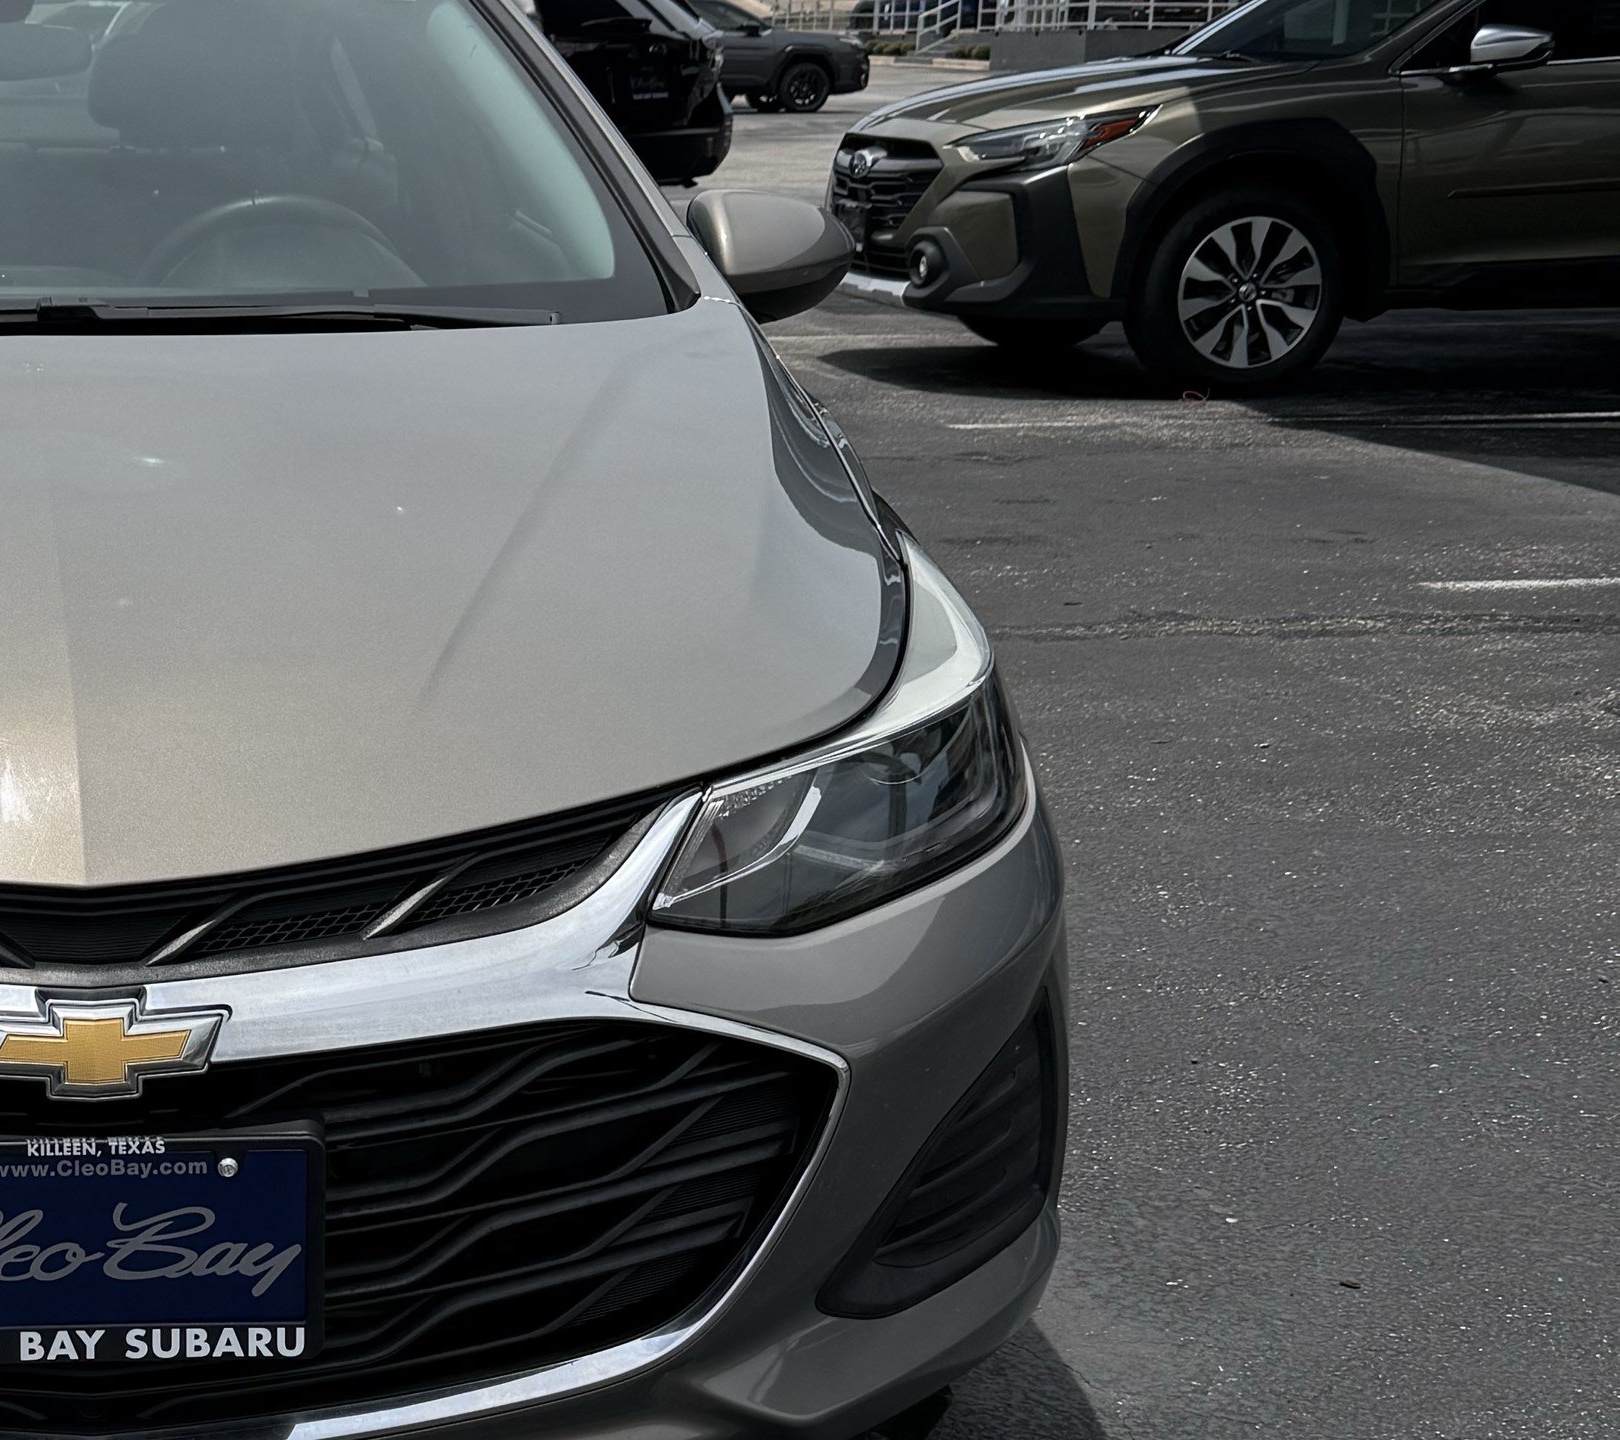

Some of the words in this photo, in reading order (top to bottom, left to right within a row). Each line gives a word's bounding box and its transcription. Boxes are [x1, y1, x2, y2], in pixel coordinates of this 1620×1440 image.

[27, 1140, 102, 1157] KILLEEN,
[108, 1139, 166, 1155] TEXAS
[102, 1202, 303, 1298] Bay
[19, 1329, 107, 1361] BAY
[124, 1327, 306, 1360] SUBARU
